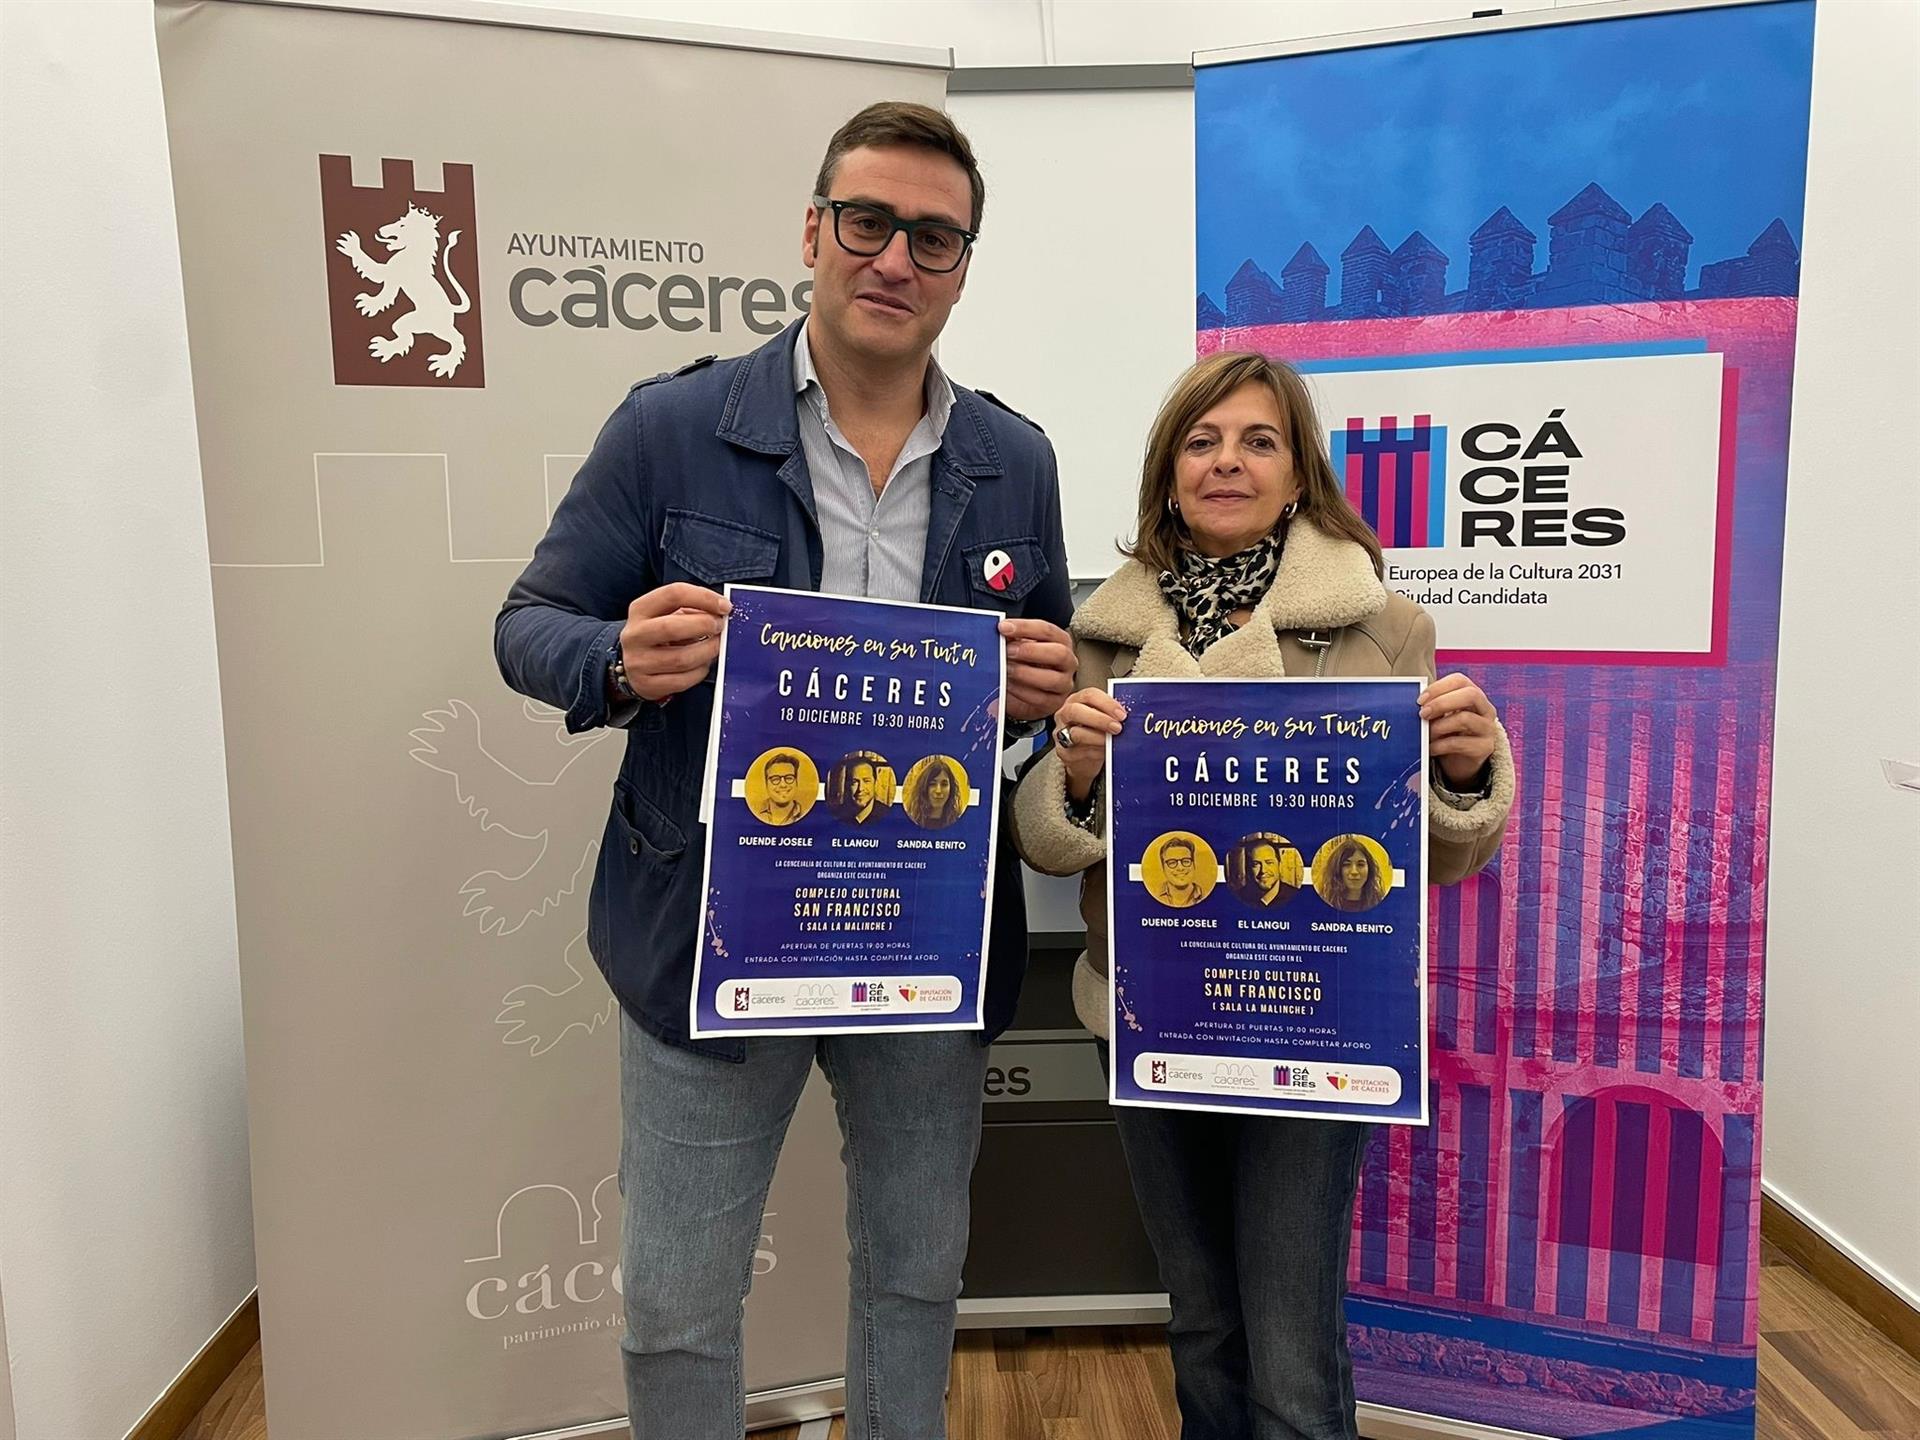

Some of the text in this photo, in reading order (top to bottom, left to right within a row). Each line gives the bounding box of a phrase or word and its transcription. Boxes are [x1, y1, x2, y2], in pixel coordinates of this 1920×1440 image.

[507, 233, 704, 264] AYUNTAMIENTO
[1460, 408, 1583, 461] CÁ
[1459, 465, 1570, 504] CE
[1461, 507, 1626, 547] RES
[1389, 563, 1623, 583] Europea de la Cultura 2031
[1458, 588, 1548, 605] Candidata
[761, 623, 977, 667] Canciones en su Tinta
[779, 667, 952, 707] CÁCERES
[780, 708, 945, 730] 18 DICIEMBRE 19:30 HORAS
[1144, 712, 1391, 739] Canciones en su Tinta
[1165, 752, 1360, 784] CÁCERES
[1169, 793, 1354, 808] 18 DICIEMBRE 19:30 HORAS
[739, 837, 813, 847] DUENDE JOSELE
[832, 839, 879, 848] EL LANGUI
[897, 840, 966, 850] SANDRA BENITO
[795, 888, 901, 899] COMPLEJO CULTURAL
[794, 903, 900, 917] SAN FRANCISCO
[806, 922, 828, 931] SALA
[831, 922, 841, 931] LA
[844, 922, 885, 931] MALINCHE
[1142, 919, 1217, 929] DUENDE JOSELE
[1238, 920, 1290, 930] EL LANGUI
[1311, 922, 1393, 934] SANDRA BENITO
[780, 942, 817, 950] APERTURA
[744, 955, 778, 963] ENTRADA
[780, 955, 798, 963] CON
[914, 954, 940, 962] AFORO
[1226, 953, 1253, 961] ORGANIZA
[1269, 954, 1285, 962] CICLO
[1296, 955, 1302, 963] EL
[1204, 968, 1321, 983] COMPLEJO CULTURAL
[869, 982, 884, 990] CÁ
[1204, 983, 1322, 1001] SAN FRANCISCO
[1220, 1002, 1242, 1012] SALA
[1245, 1004, 1256, 1012] LA
[1261, 1004, 1306, 1015] MALINCHE
[1194, 1022, 1233, 1030] APERTURA
[1249, 1024, 1284, 1033] PUERTAS
[1309, 1027, 1337, 1035] HORAS
[1159, 1031, 1194, 1040] ENTRADA
[1264, 1037, 1289, 1045] HASTA
[1292, 1039, 1340, 1048] COMPLETAR
[1342, 1041, 1372, 1050] AFORO
[1292, 1065, 1310, 1075] CÁ
[503, 1316, 600, 1350] patrimonio
